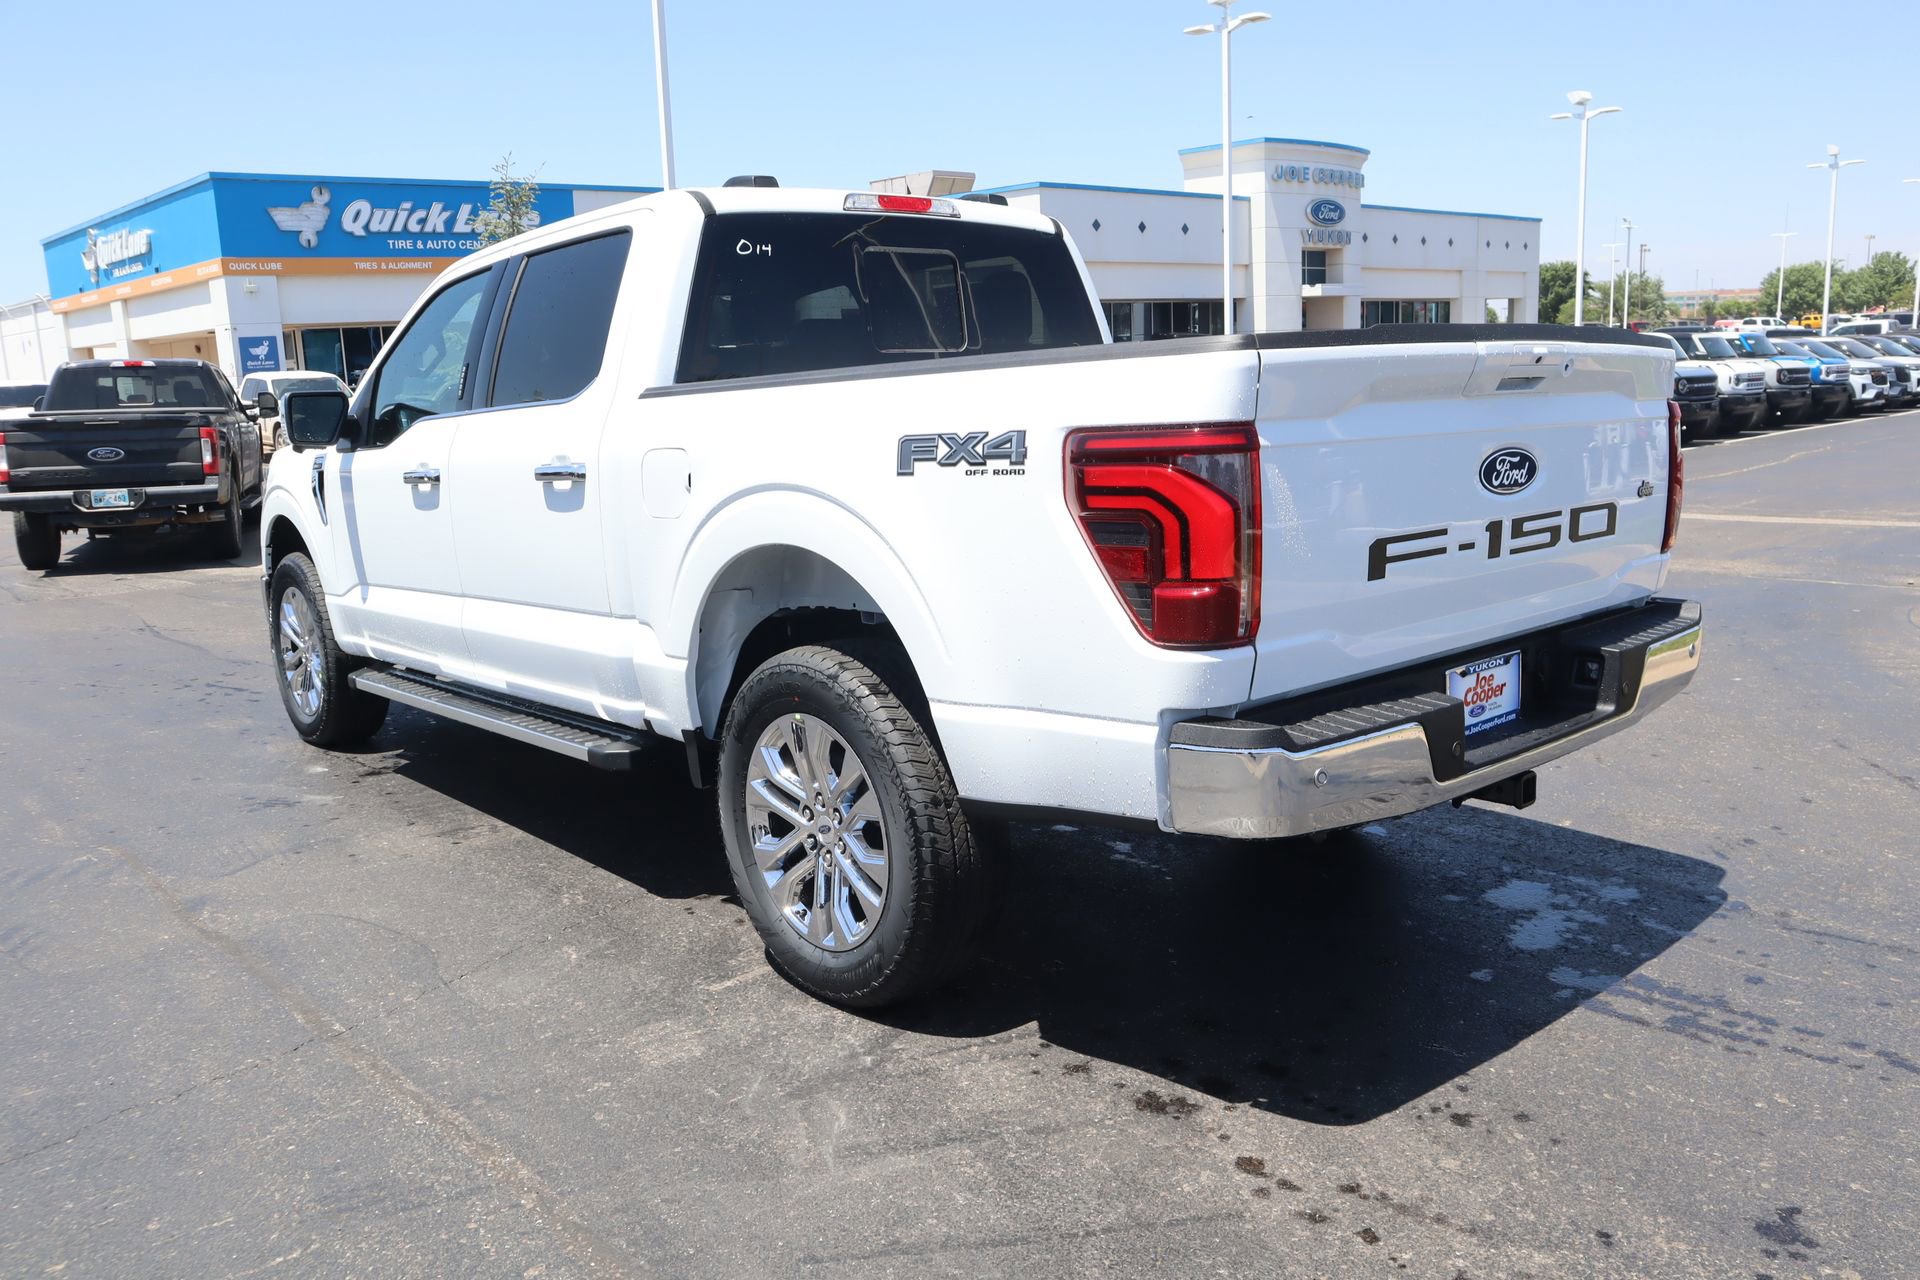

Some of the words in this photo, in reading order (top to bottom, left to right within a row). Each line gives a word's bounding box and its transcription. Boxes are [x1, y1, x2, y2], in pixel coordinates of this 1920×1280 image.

[1272, 165, 1310, 183] JOE
[341, 199, 454, 236] Quick
[1318, 204, 1340, 220] Ford
[387, 240, 413, 249] TIRE
[416, 240, 425, 249] &
[427, 240, 456, 249] AUTO
[1302, 229, 1351, 245] YUKON
[229, 262, 257, 270] QUICK
[259, 262, 283, 270] LUBE
[354, 262, 377, 270] TIRES
[388, 261, 432, 269] ALIGNMENT
[96, 450, 116, 458] Ford
[897, 430, 1027, 476] FX4
[993, 468, 1025, 476] ROAD
[1492, 455, 1529, 486] Ford
[1367, 502, 1618, 582] F-150
[1469, 658, 1504, 674] YUKON
[1473, 672, 1495, 691] Joe
[1463, 682, 1507, 707] Cooper
